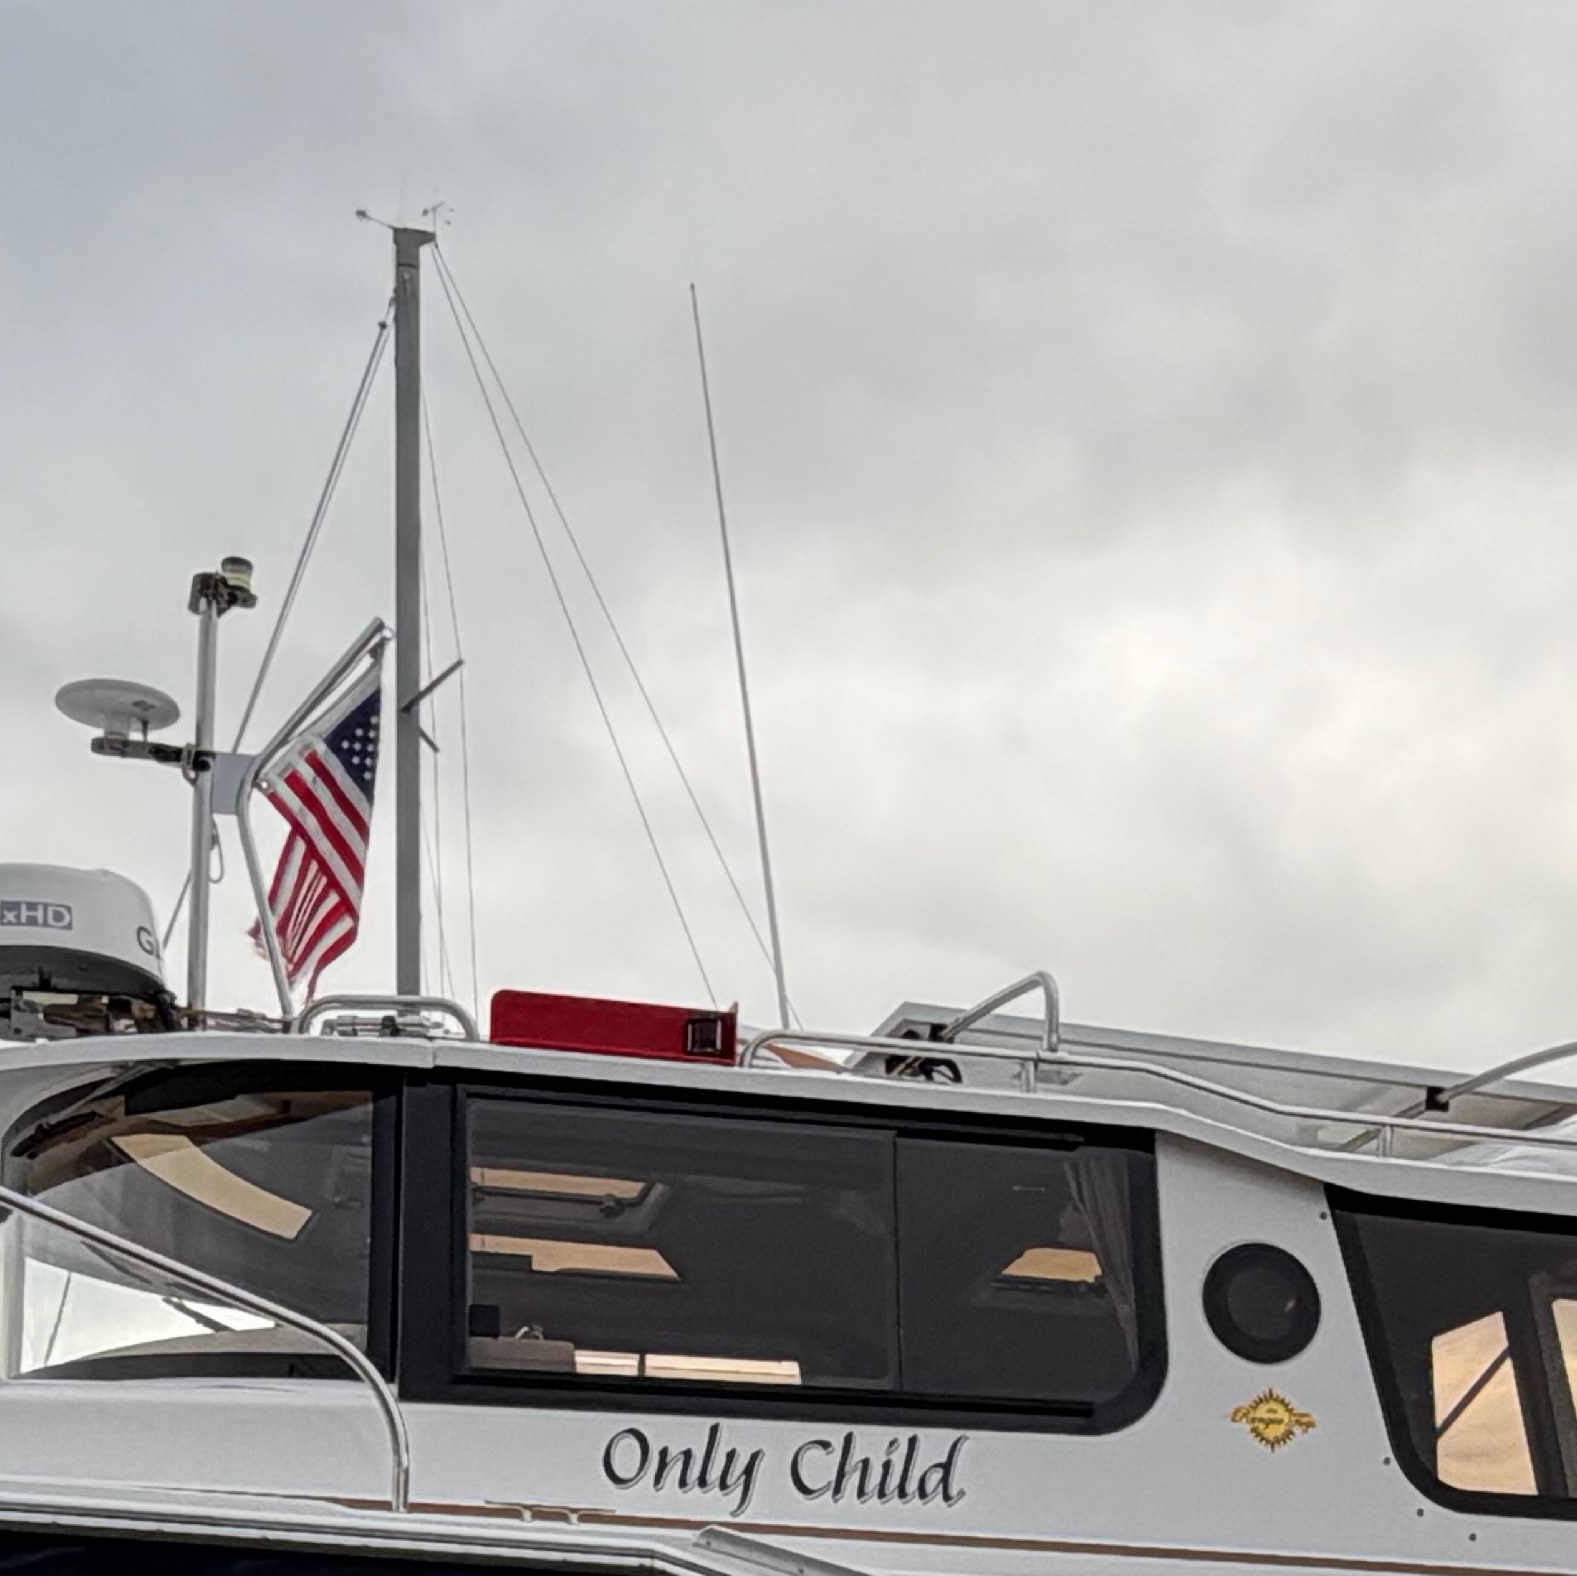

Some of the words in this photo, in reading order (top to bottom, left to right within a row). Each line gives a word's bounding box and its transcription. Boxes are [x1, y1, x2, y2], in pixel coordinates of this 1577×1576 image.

[1, 902, 72, 929] xHD
[602, 1422, 765, 1518] Only
[790, 1431, 970, 1508] Child
